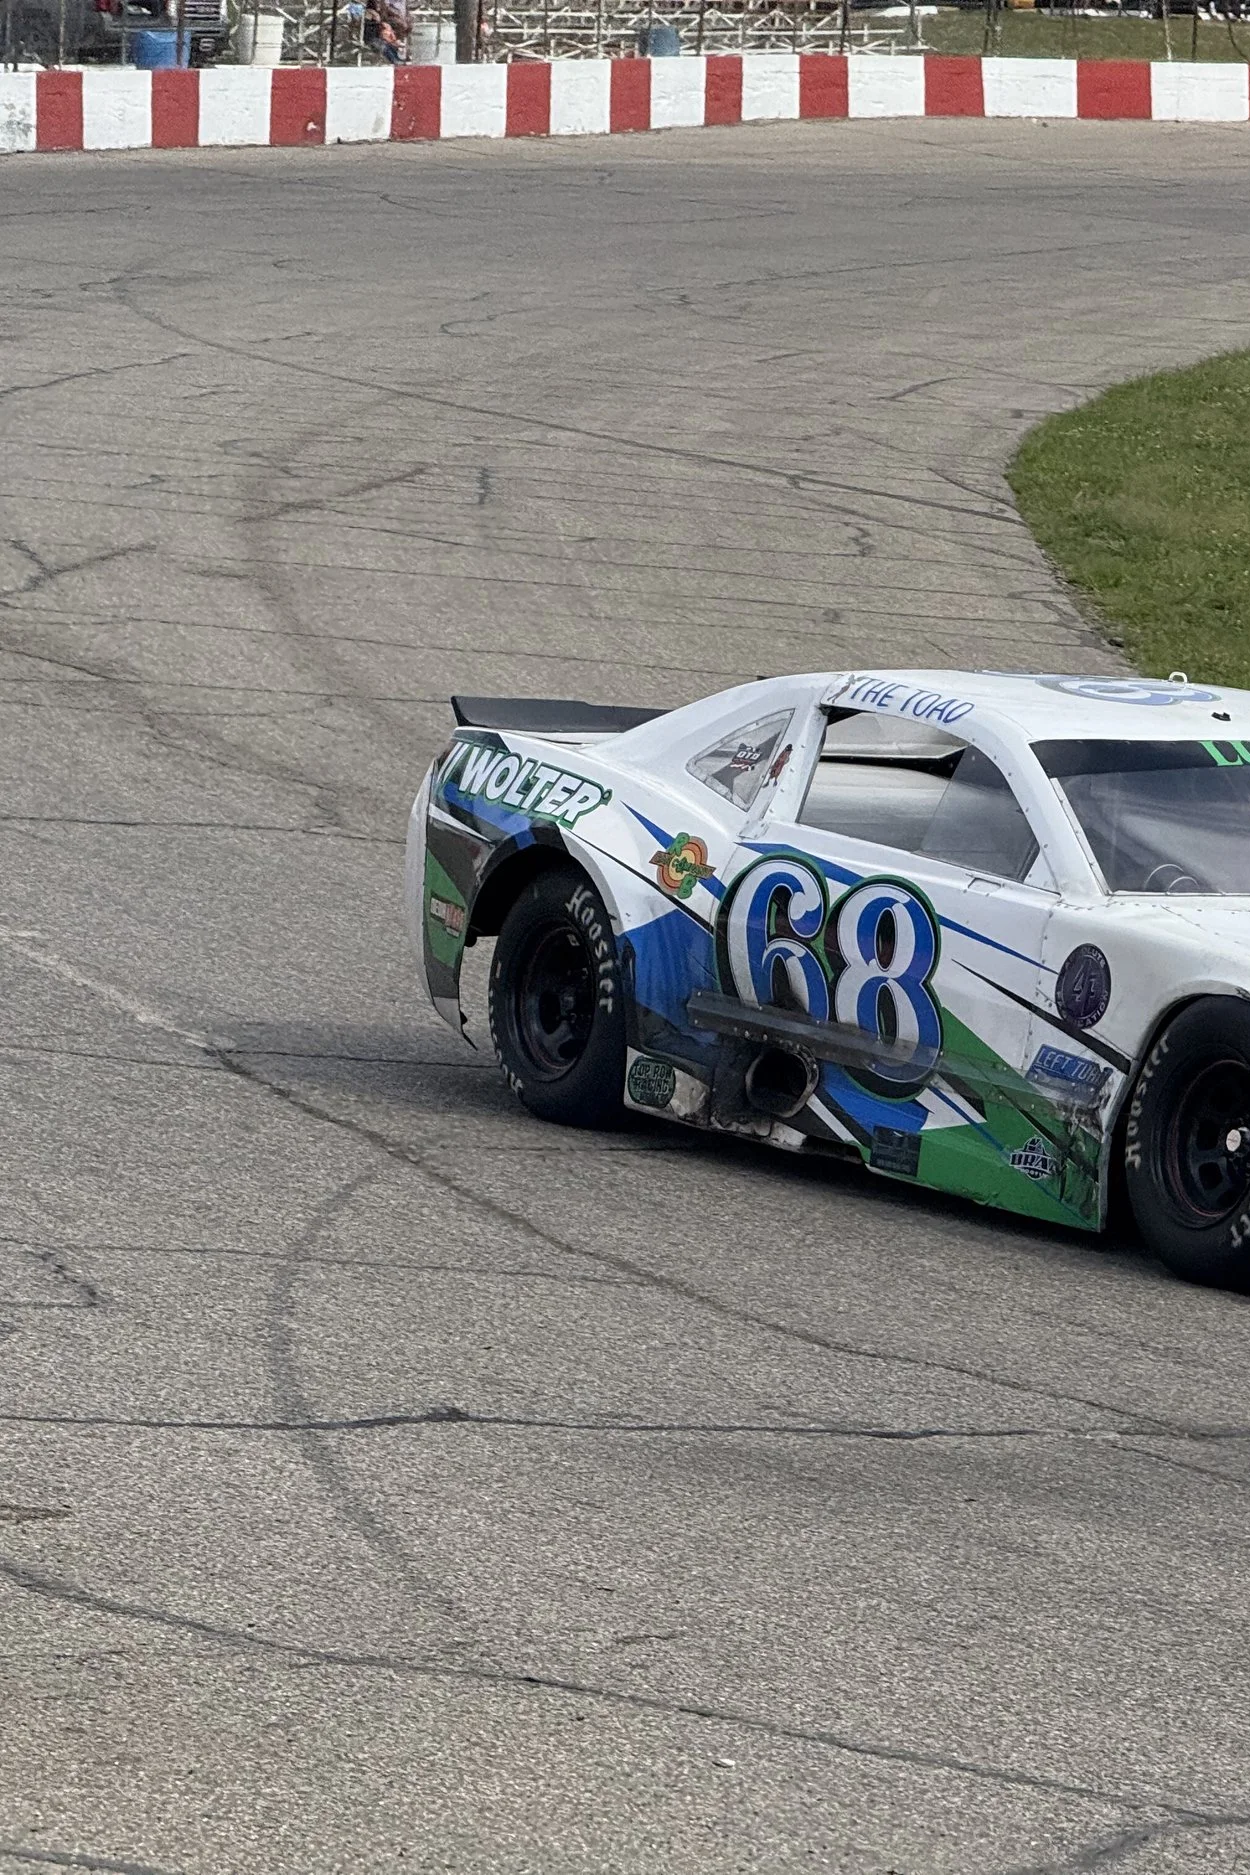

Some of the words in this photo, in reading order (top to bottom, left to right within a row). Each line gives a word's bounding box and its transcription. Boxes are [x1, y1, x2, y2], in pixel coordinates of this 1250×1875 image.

[850, 676, 909, 708] THE
[899, 688, 975, 724] TOAD
[458, 745, 602, 824] WOLTER
[565, 885, 614, 1014] Hoosier
[714, 852, 945, 1102] 68
[1035, 1047, 1073, 1070] LEFT
